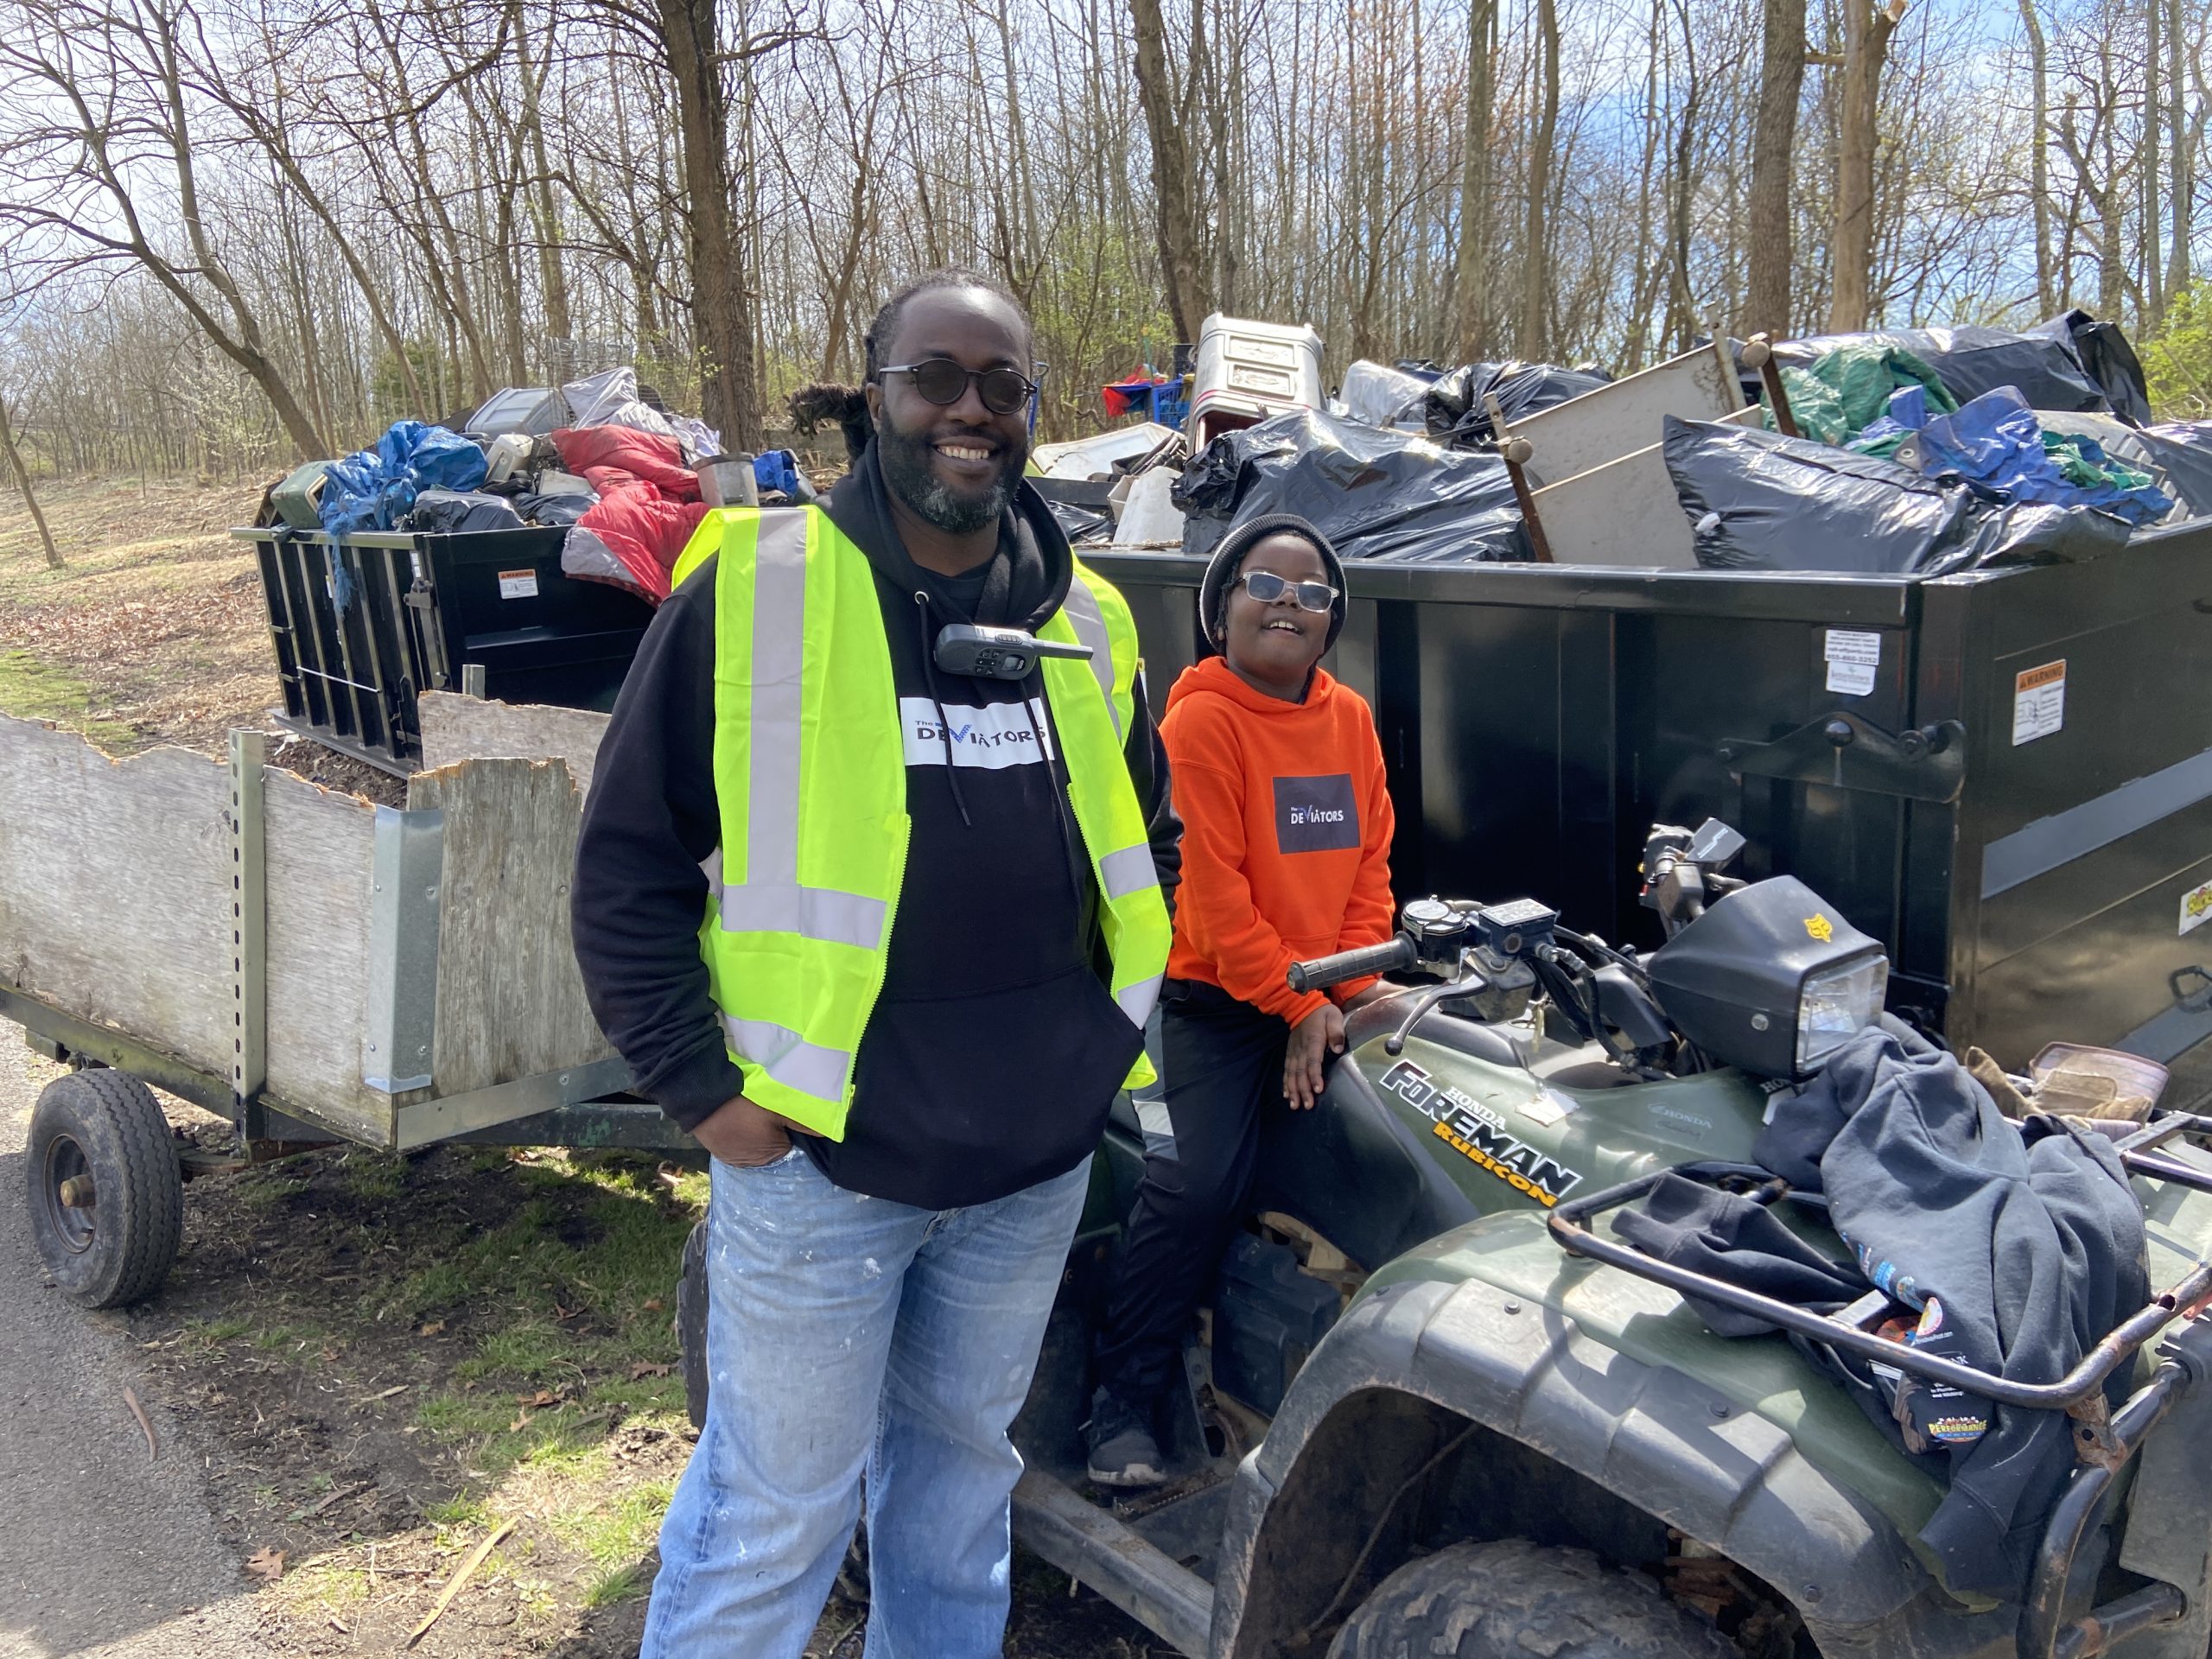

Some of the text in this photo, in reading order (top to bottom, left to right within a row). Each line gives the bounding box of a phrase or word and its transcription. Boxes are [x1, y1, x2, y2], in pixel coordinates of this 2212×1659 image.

[2026, 665, 2063, 686] WARNING
[1290, 804, 1344, 824] DEVIATORS
[1445, 1085, 1508, 1131] HONDA
[1664, 1107, 1713, 1129] HONDA
[1379, 1058, 1584, 1198] FOREMAN
[1433, 1121, 1559, 1208] RUBICON
[1928, 1420, 1987, 1434] PERFORMANCE
